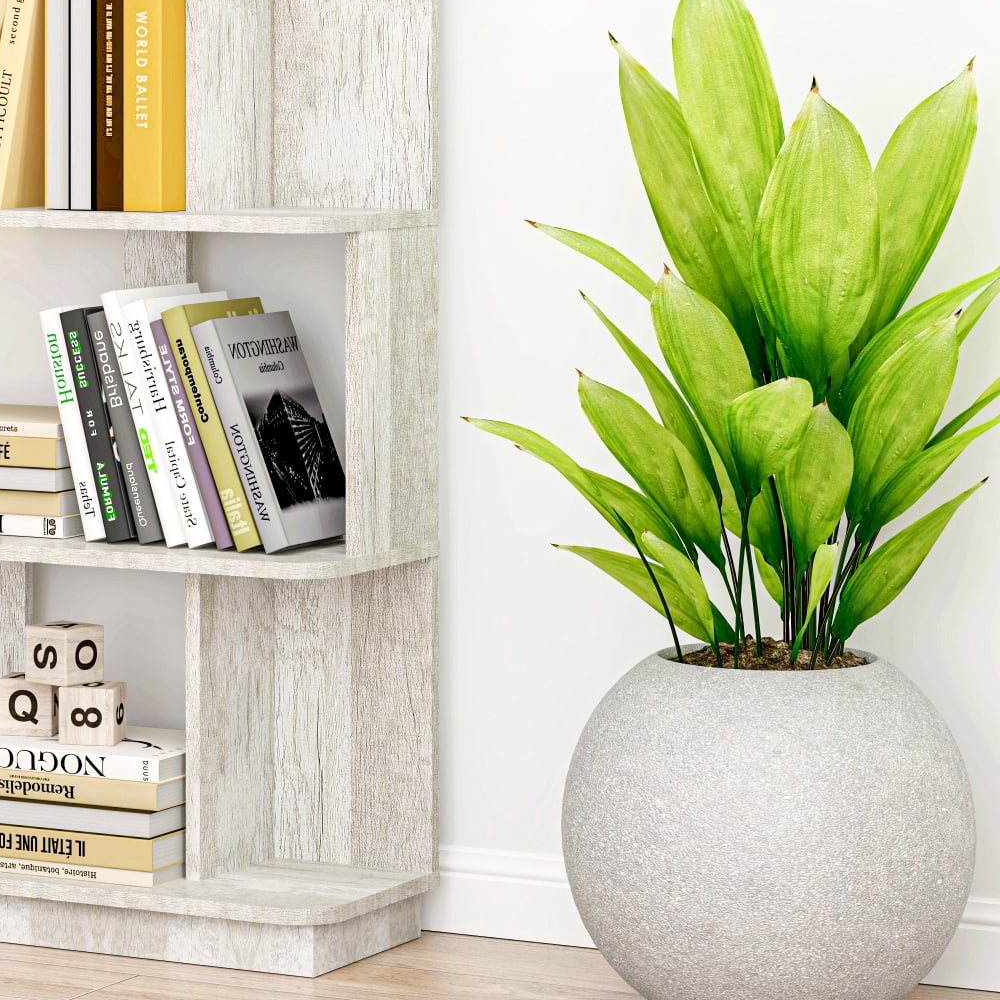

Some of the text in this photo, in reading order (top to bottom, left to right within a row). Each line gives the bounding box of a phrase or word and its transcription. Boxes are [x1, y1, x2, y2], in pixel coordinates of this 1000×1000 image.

[10, 6, 22, 45] second
[135, 10, 149, 129] WORLD BALLET
[33, 642, 58, 670] S
[8, 689, 39, 725] Q
[70, 707, 102, 729] 8
[15, 833, 38, 852] UNE
[41, 836, 73, 858] ÉTAIT
[76, 840, 86, 857] IL
[0, 861, 17, 870] arts
[19, 862, 60, 877] botanique,
[62, 867, 97, 880] Histoire,
